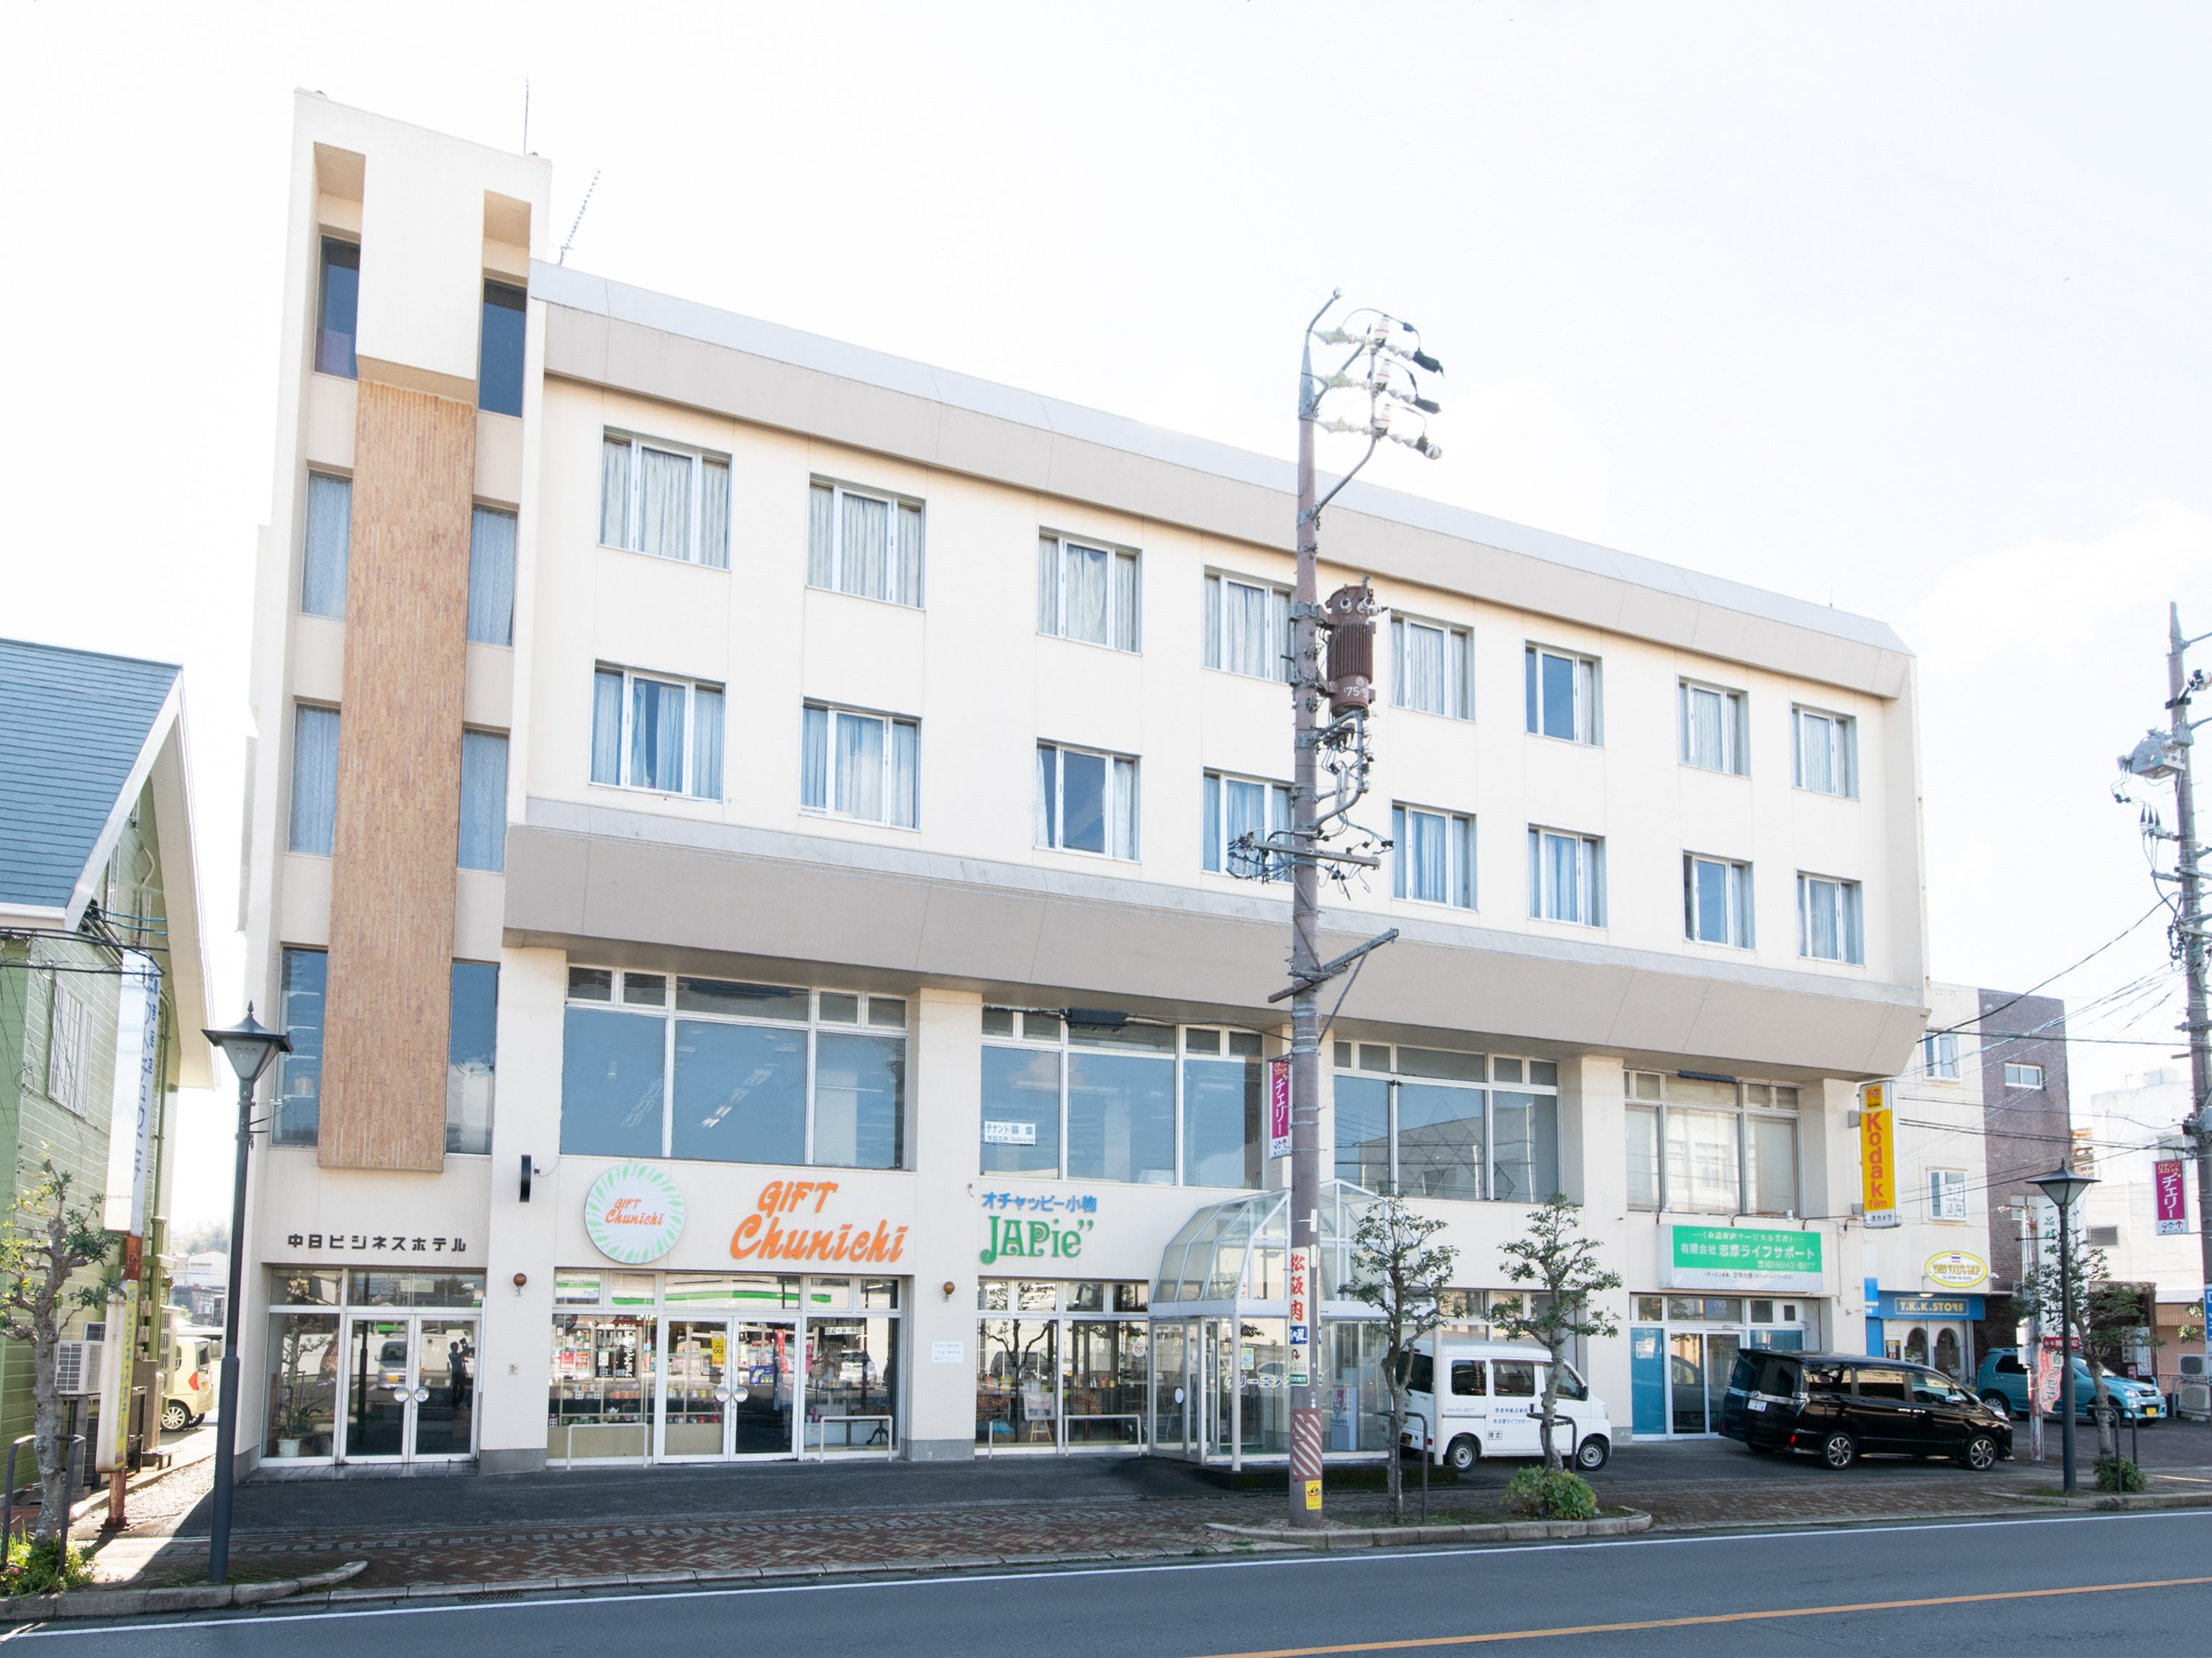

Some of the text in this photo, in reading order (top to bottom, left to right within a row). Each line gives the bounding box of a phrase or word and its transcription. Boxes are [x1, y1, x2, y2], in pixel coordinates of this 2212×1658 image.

[1867, 1112, 1884, 1198] Kodak
[614, 1198, 642, 1210] GIFT
[758, 1181, 838, 1218] GIFT
[982, 1192, 1097, 1213] オチャッピー小物
[1869, 1200, 1887, 1210] film
[2162, 1175, 2178, 1218] チェリー
[288, 1233, 466, 1252] 中日ビジネスホテル
[1680, 1243, 1816, 1259] 有限会社 志摩ライフサポート
[1290, 1254, 1305, 1321] 松阪肉
